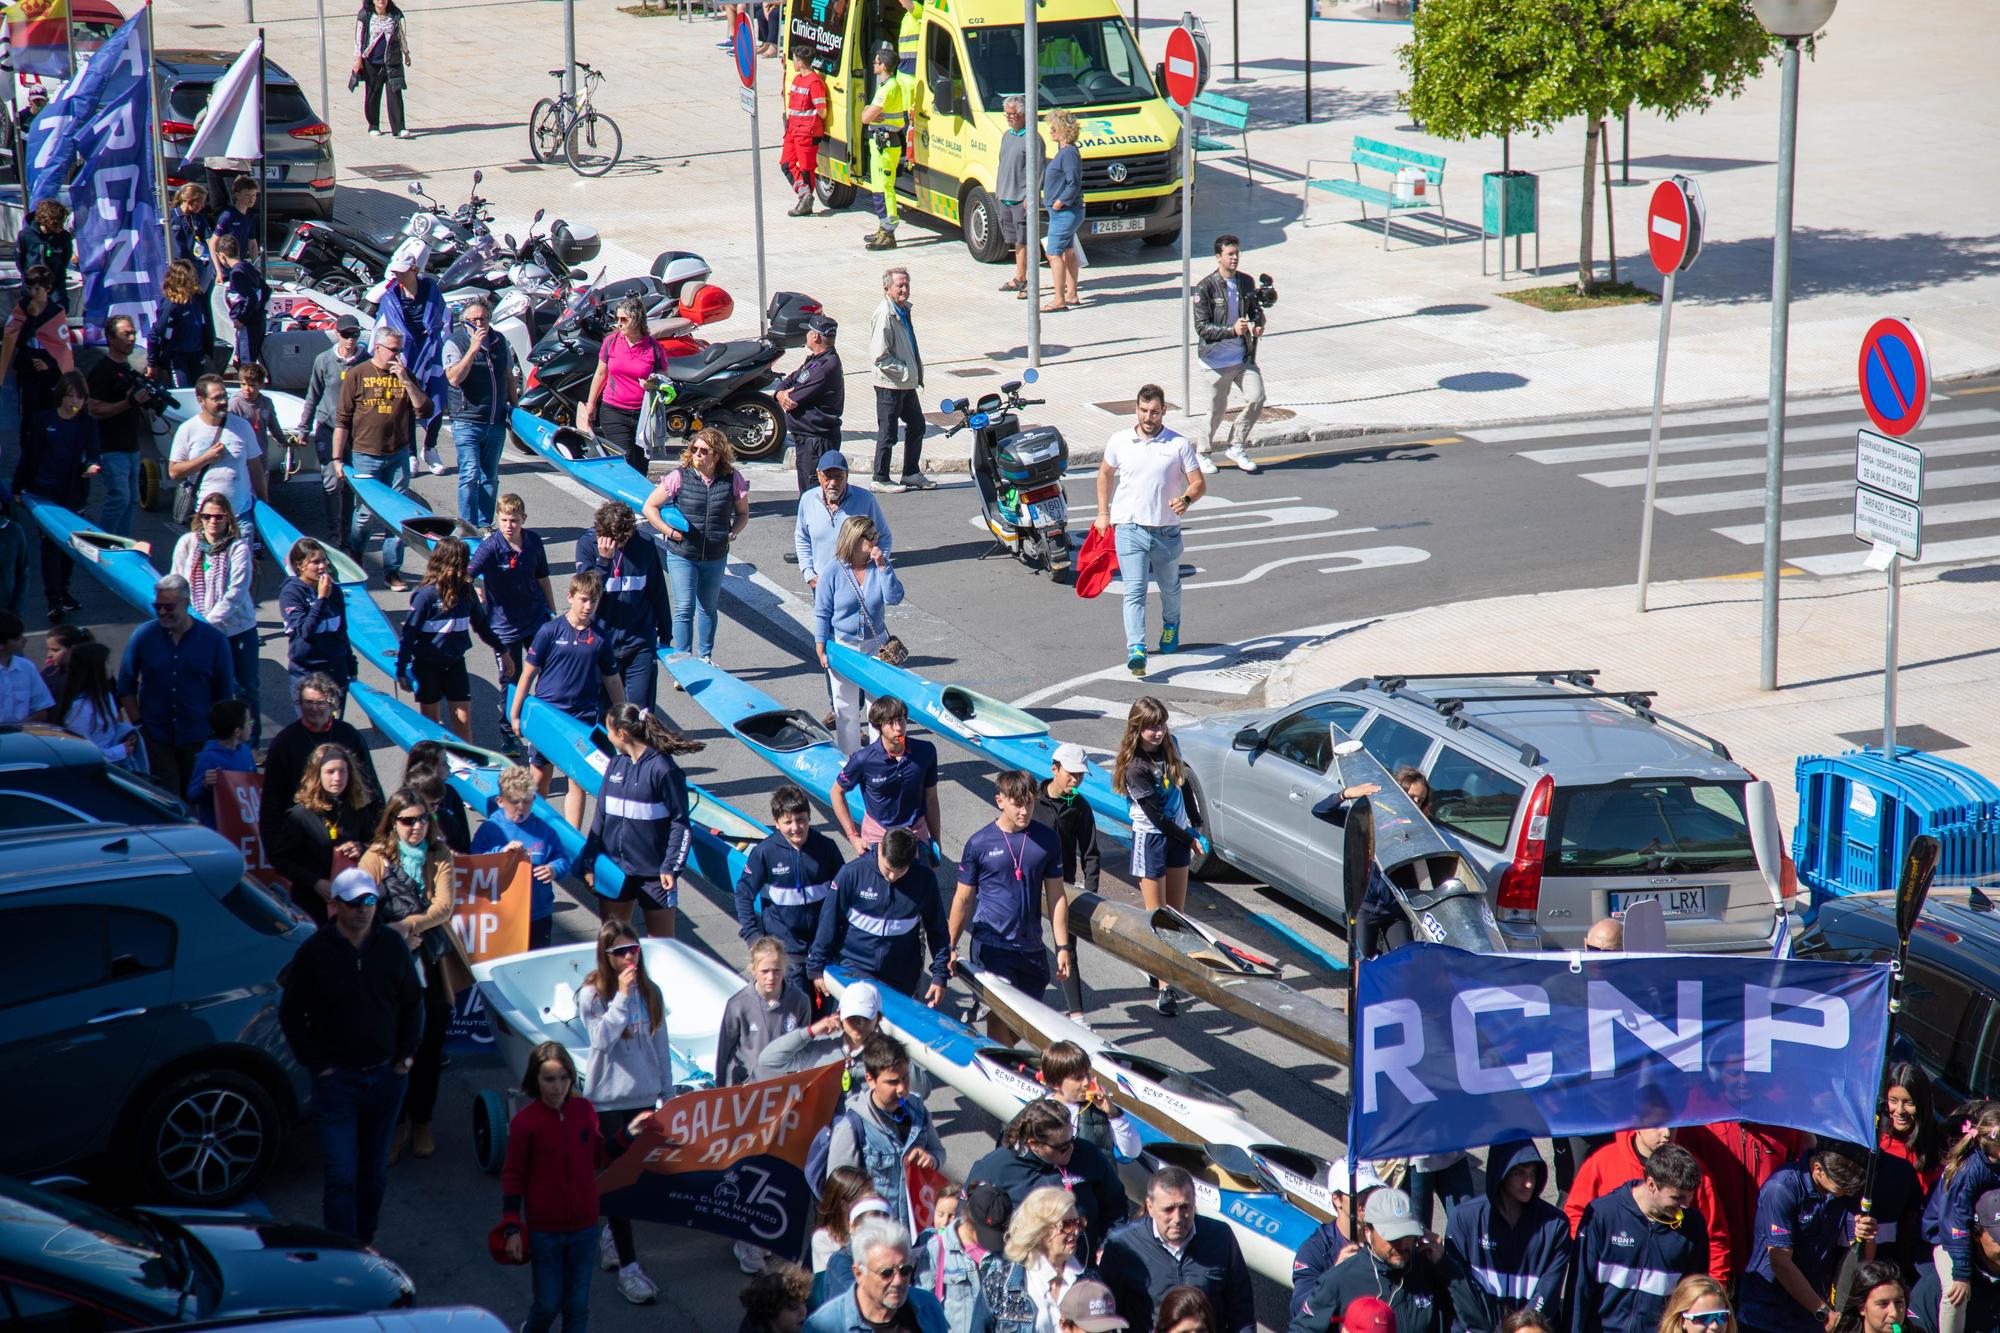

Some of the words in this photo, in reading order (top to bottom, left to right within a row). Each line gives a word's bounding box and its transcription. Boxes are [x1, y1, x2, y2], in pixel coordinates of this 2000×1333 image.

[791, 18, 816, 41] Clínica
[816, 26, 843, 51] Rotger
[1099, 221, 1124, 233] 2485
[1126, 219, 1143, 230] JBL
[1889, 505, 1907, 519] SECTOR
[1670, 890, 1699, 912] LRX
[1363, 980, 1850, 1115] RCNP
[995, 1068, 1015, 1082] RCNP
[1017, 1079, 1039, 1096] TEAM
[1143, 1086, 1163, 1098] RCNP
[1165, 1095, 1188, 1110] TEAM
[643, 1147, 683, 1162] EL
[1284, 1171, 1304, 1187] RCNP
[1305, 1182, 1326, 1200] TEAM
[668, 1191, 696, 1201] REAL
[700, 1195, 729, 1208] CLUB
[740, 1164, 788, 1240] 75
[695, 1204, 709, 1213] DE
[713, 1207, 747, 1223] PALMA
[1229, 1201, 1281, 1235] NELO
